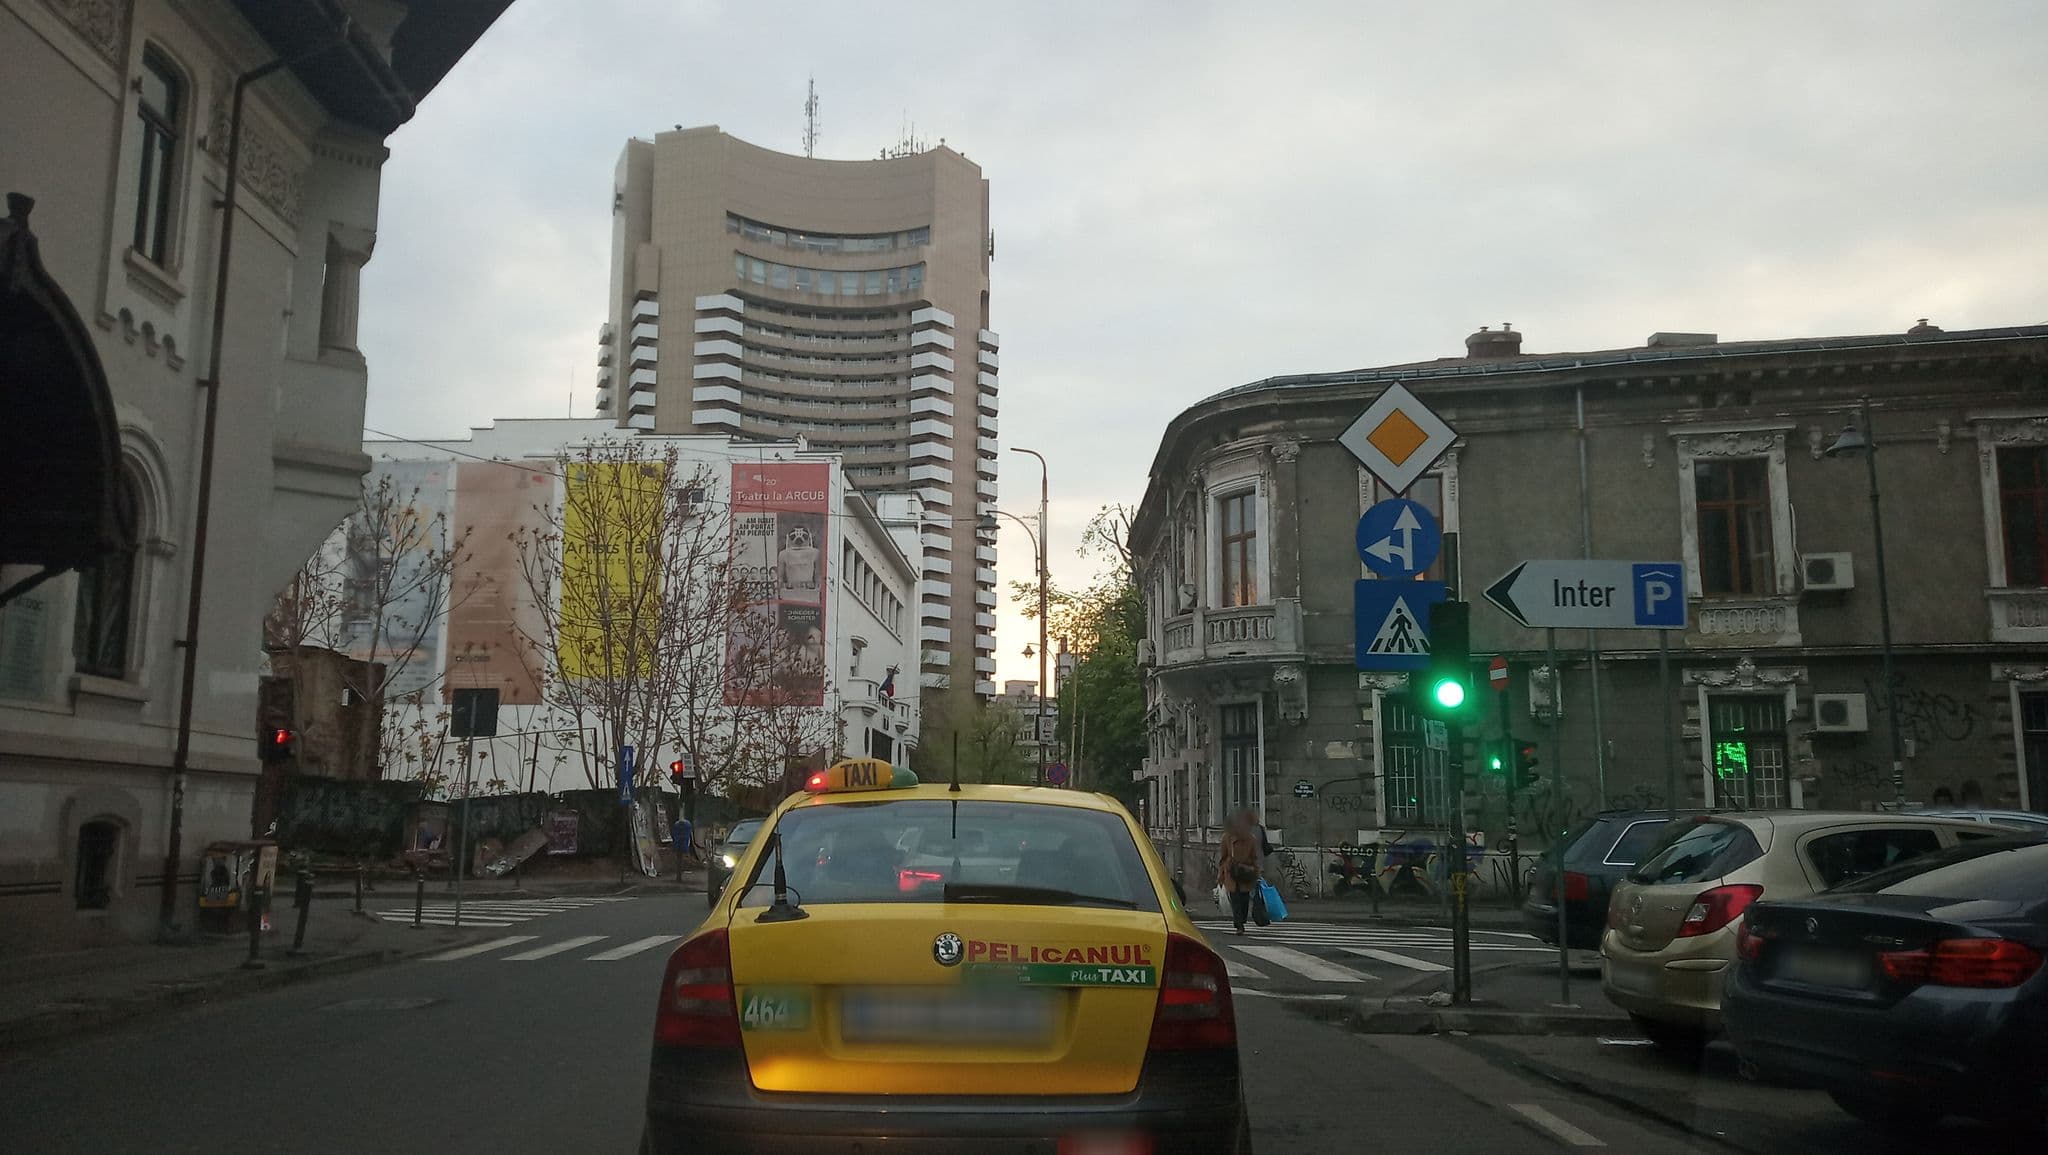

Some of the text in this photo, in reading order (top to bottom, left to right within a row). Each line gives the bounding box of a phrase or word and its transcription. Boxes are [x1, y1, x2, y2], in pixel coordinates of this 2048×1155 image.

[735, 490, 825, 501] Teatru la ARCUB
[1553, 578, 1672, 616] Inter P
[840, 762, 877, 787] TAXI
[967, 939, 1152, 966] PELICANUL
[1070, 968, 1147, 983] Plus TAXI
